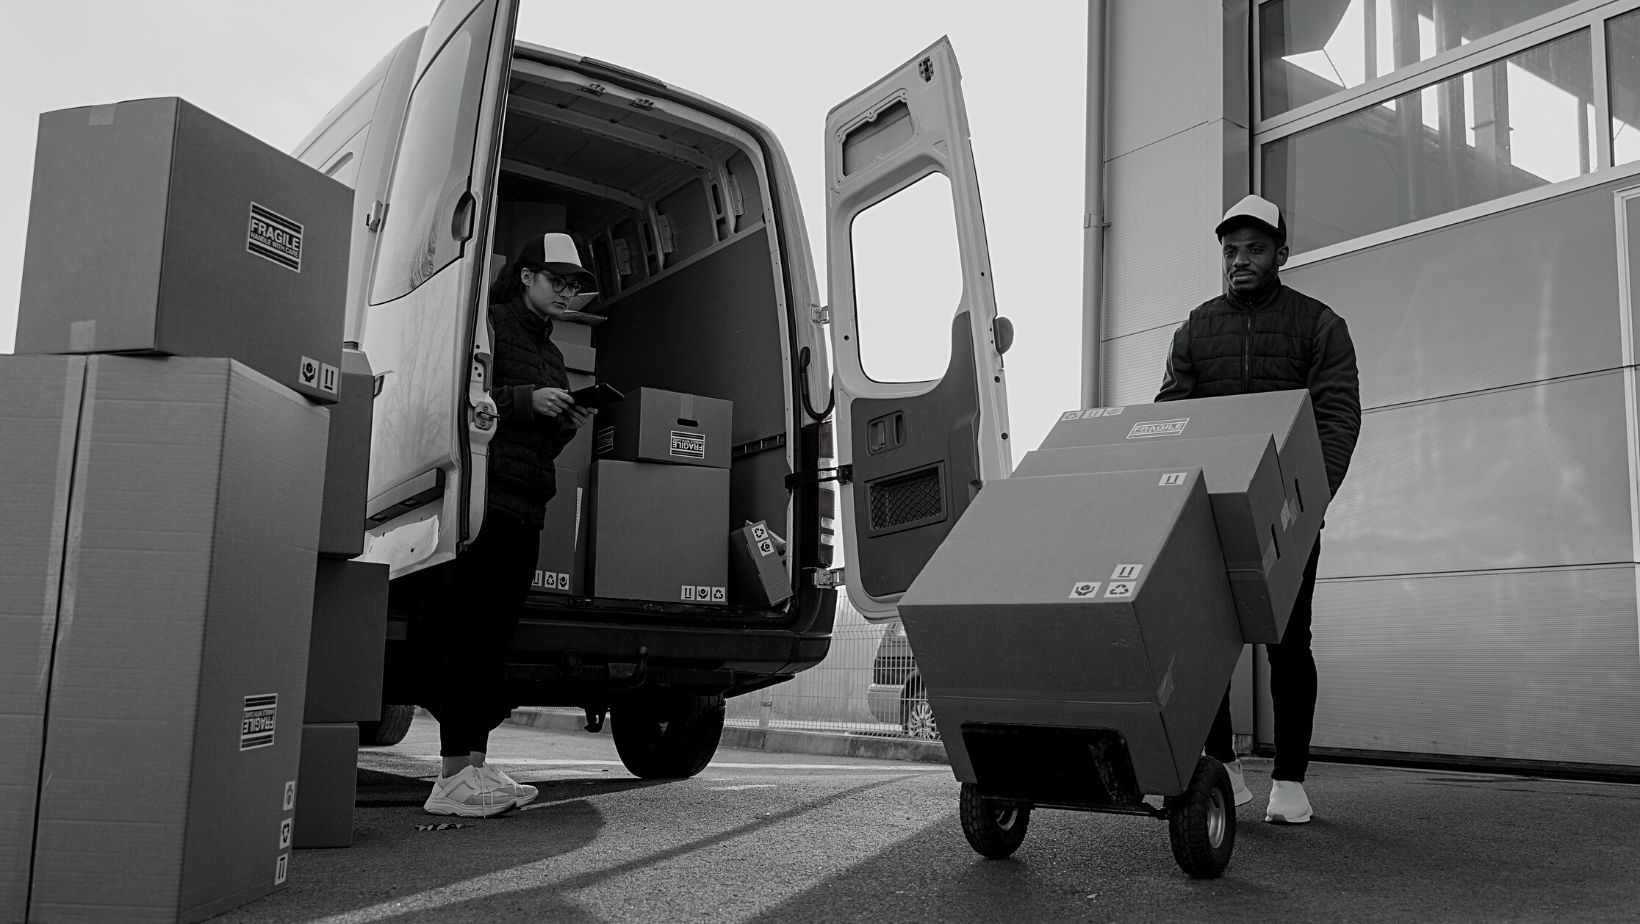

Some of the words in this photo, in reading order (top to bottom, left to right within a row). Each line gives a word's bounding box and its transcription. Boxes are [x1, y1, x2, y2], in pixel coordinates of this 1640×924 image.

[250, 219, 300, 251] FRAGILE
[250, 232, 271, 245] HANDLE
[272, 240, 285, 251] WITH
[285, 245, 299, 258] CARE
[672, 441, 703, 451] FRAGILE
[243, 715, 274, 733] FRAGILE
